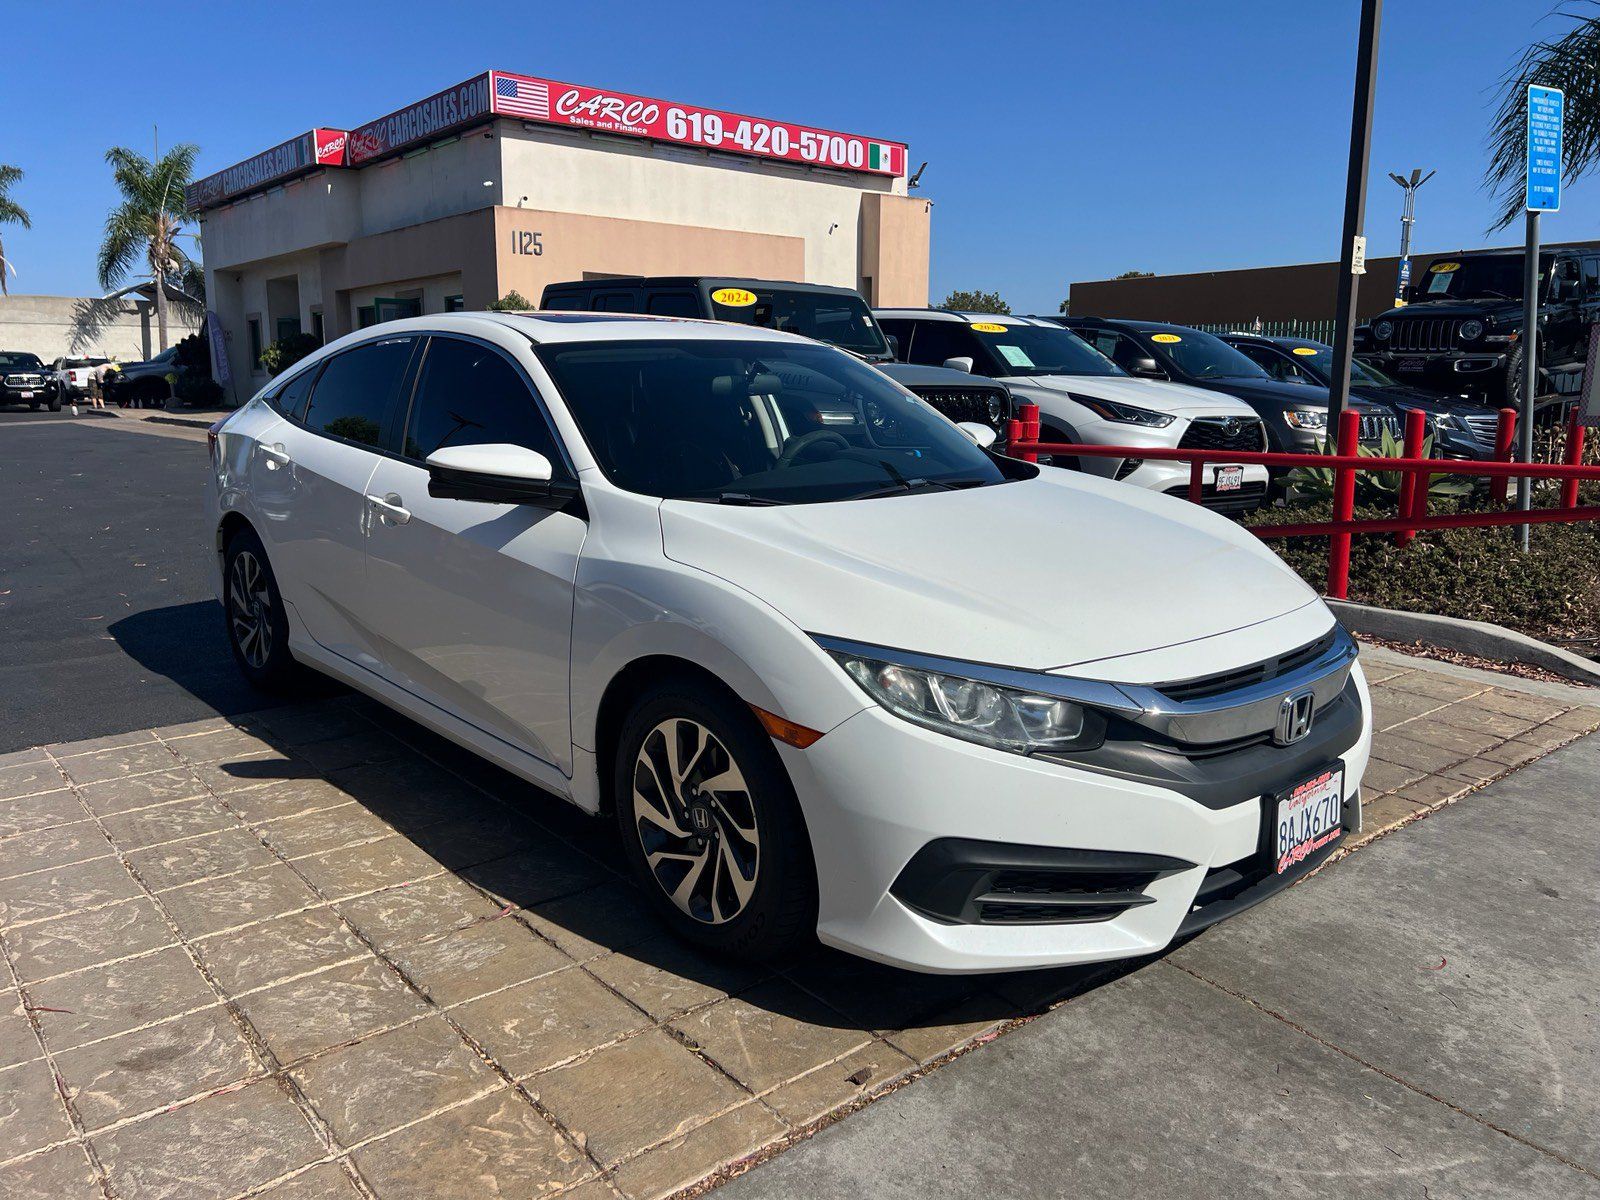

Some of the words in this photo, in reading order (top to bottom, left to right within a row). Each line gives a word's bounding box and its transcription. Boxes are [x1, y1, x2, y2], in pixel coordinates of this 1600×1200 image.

[555, 89, 660, 126] CARCO
[666, 107, 864, 168] 619-420-5700
[569, 115, 595, 126] Sales
[596, 121, 613, 129] and
[614, 122, 649, 135] Finance
[317, 137, 345, 158] CARCO
[511, 230, 543, 256] 1125
[720, 292, 750, 303] 2024
[1280, 793, 1340, 856] 8AJX670
